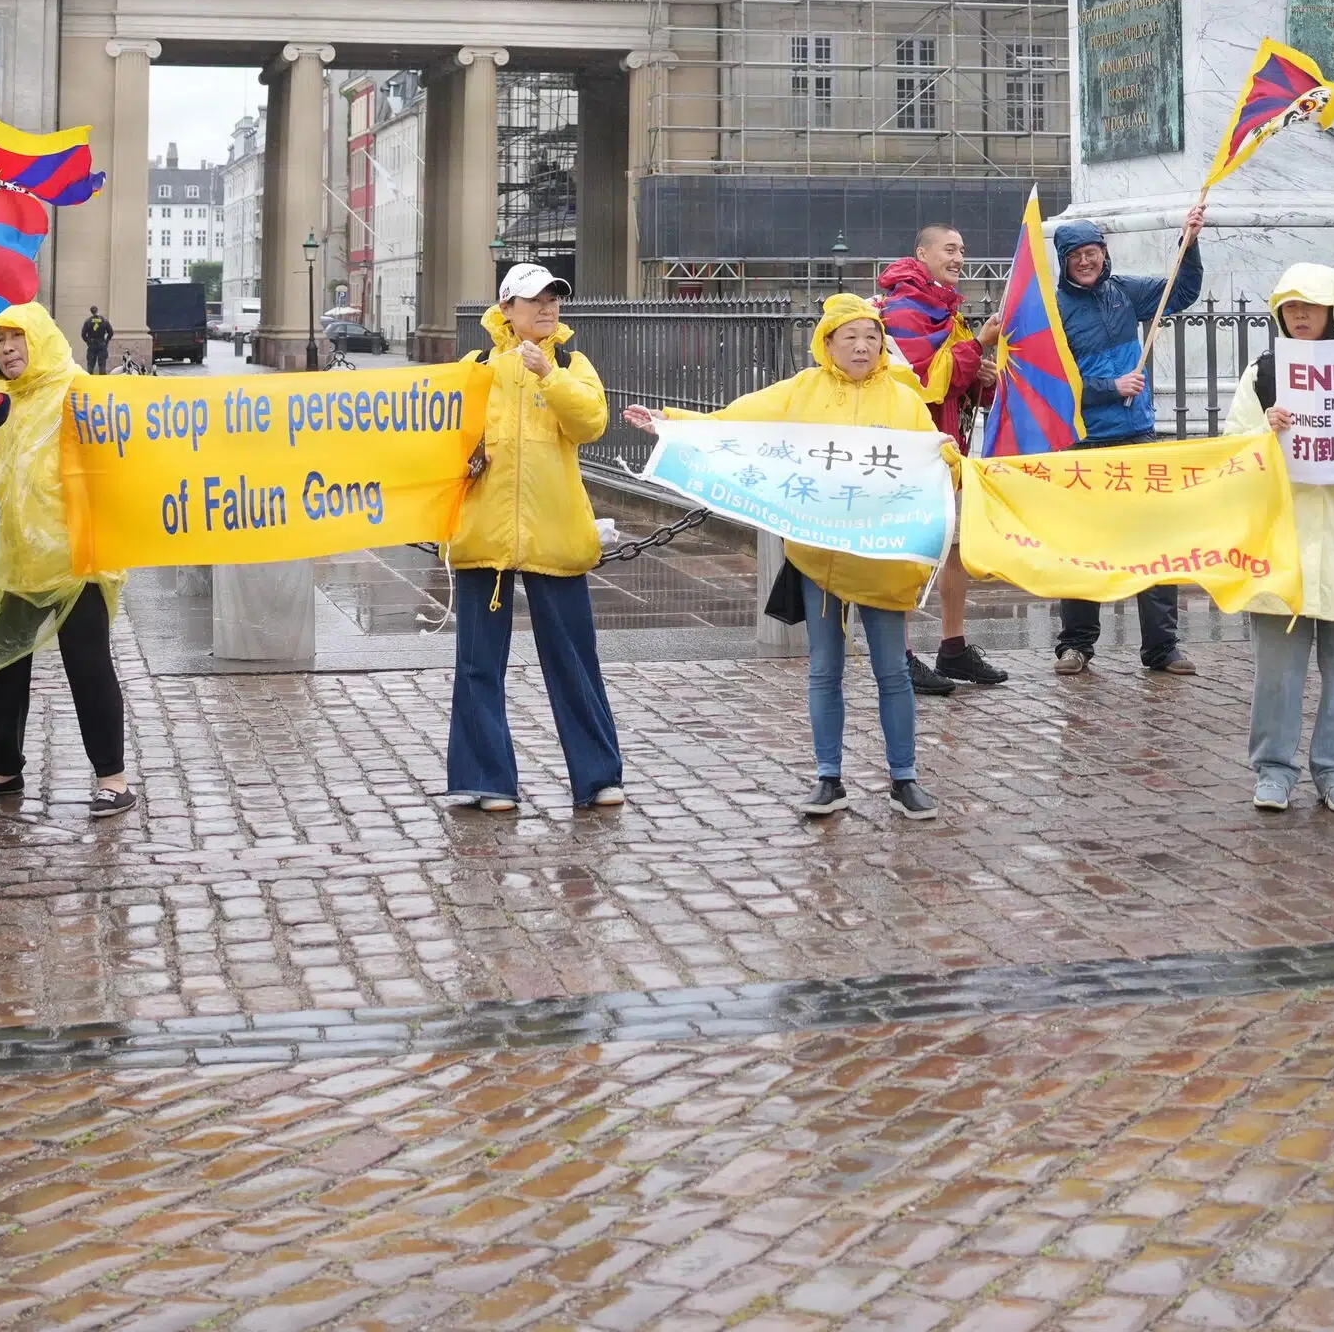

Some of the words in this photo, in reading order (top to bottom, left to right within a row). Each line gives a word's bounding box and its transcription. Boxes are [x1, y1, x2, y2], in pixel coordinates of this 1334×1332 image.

[1099, 51, 1152, 76] MONUMENTUM
[71, 393, 130, 457] Help
[146, 394, 208, 451] stop
[224, 388, 270, 433] the
[288, 378, 463, 446] persecution
[1290, 413, 1332, 428] CHINESE
[162, 479, 188, 535] of
[203, 475, 286, 531] Falun
[302, 471, 383, 524] Gong
[710, 482, 851, 549] Disintegrating
[859, 534, 907, 549] Now
